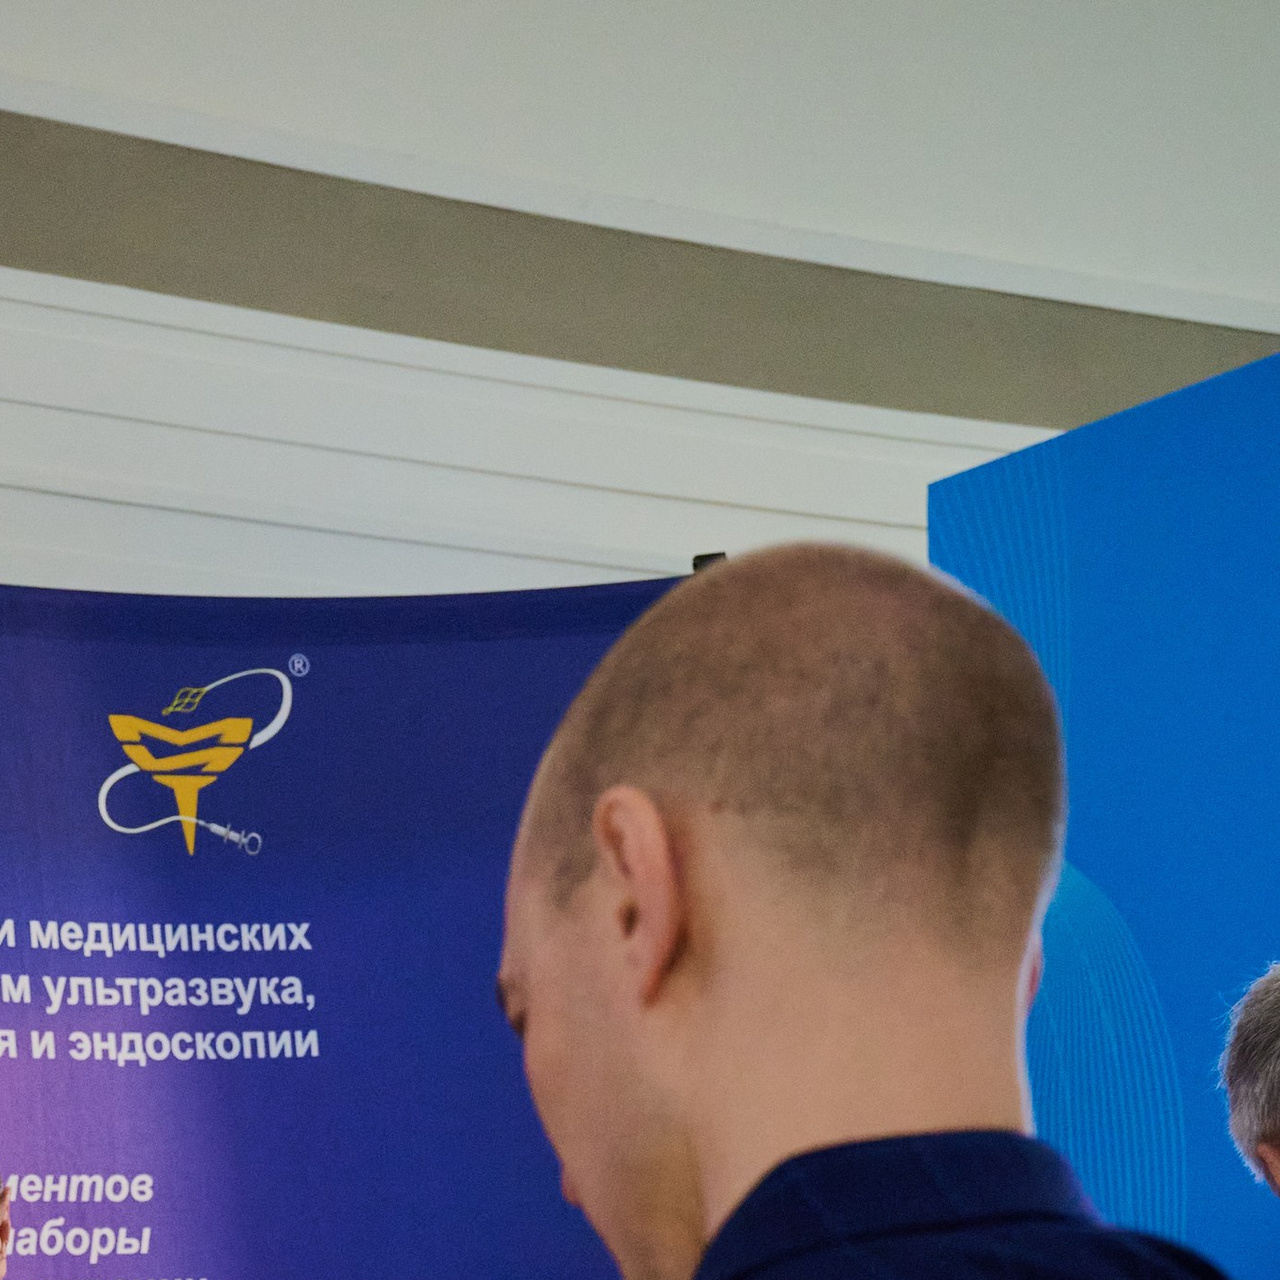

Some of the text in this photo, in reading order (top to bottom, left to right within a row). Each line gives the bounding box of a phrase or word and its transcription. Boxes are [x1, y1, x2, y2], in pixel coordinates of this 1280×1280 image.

[29, 918, 313, 959] медицинских
[43, 973, 316, 1016] ультразвука,
[30, 1029, 56, 1060] и
[68, 1028, 320, 1068] эндоскопии
